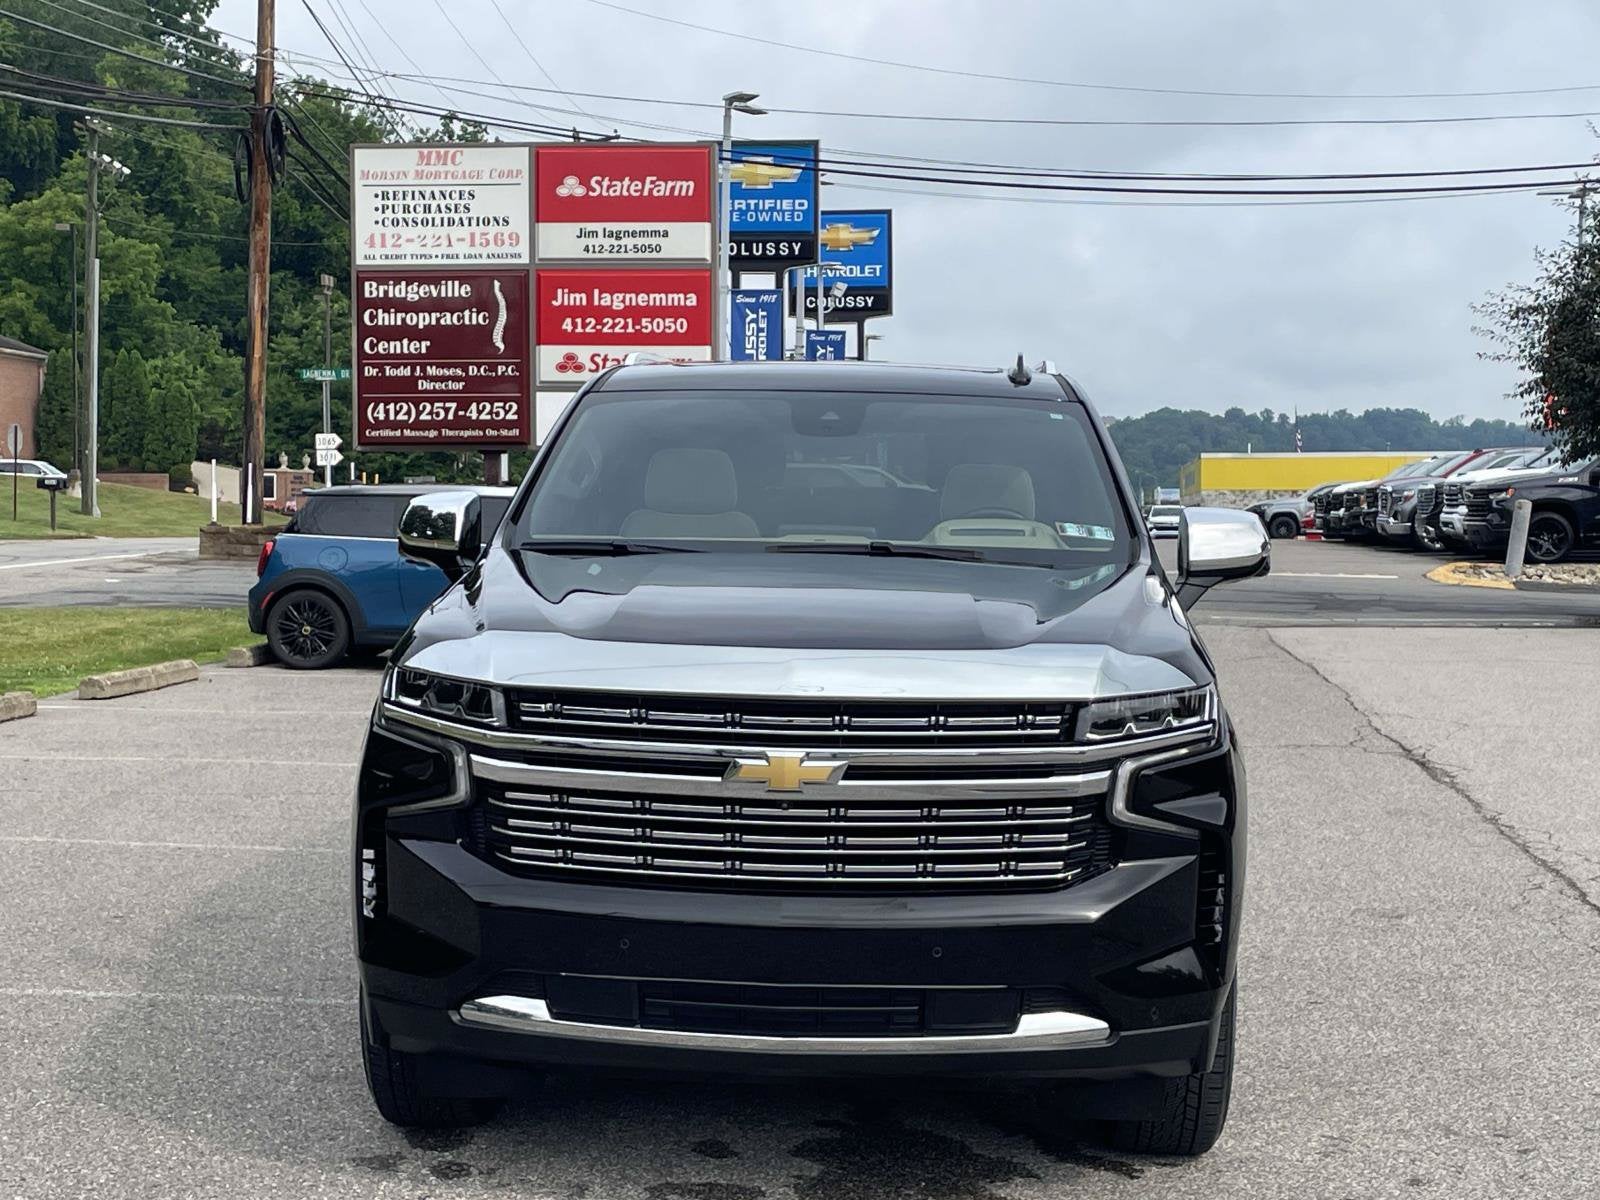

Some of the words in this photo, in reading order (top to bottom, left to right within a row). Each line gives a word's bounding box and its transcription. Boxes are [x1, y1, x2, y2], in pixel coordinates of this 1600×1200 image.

[416, 150, 464, 166] MMC
[412, 169, 484, 180] MORTGAGE
[489, 168, 524, 180] CORP.
[381, 190, 476, 201] REFINANCES
[381, 203, 471, 214] PURCHASES
[381, 216, 510, 227] CONSOLIDATIONS
[364, 232, 520, 248] 412-221-1569
[576, 227, 600, 239] Jim
[602, 227, 670, 240] Iagnemma
[582, 243, 662, 254] 412-221-5050
[364, 280, 471, 302] Bridgeville
[552, 288, 586, 306] Jim
[594, 288, 698, 310] Iagnemma
[736, 294, 756, 303] Since
[363, 307, 490, 328] Chiropractic
[562, 318, 688, 333] 412-221-5050
[363, 336, 431, 354] Center
[364, 365, 382, 377] Dr.
[385, 364, 411, 376] Todd
[414, 364, 424, 377] J.
[426, 365, 466, 378] Moses,
[497, 365, 520, 376] P.C.
[418, 379, 465, 391] Director
[366, 428, 400, 437] Certified
[403, 428, 438, 439] Massage
[441, 428, 483, 439] Therapists
[485, 428, 520, 437] On-Staff
